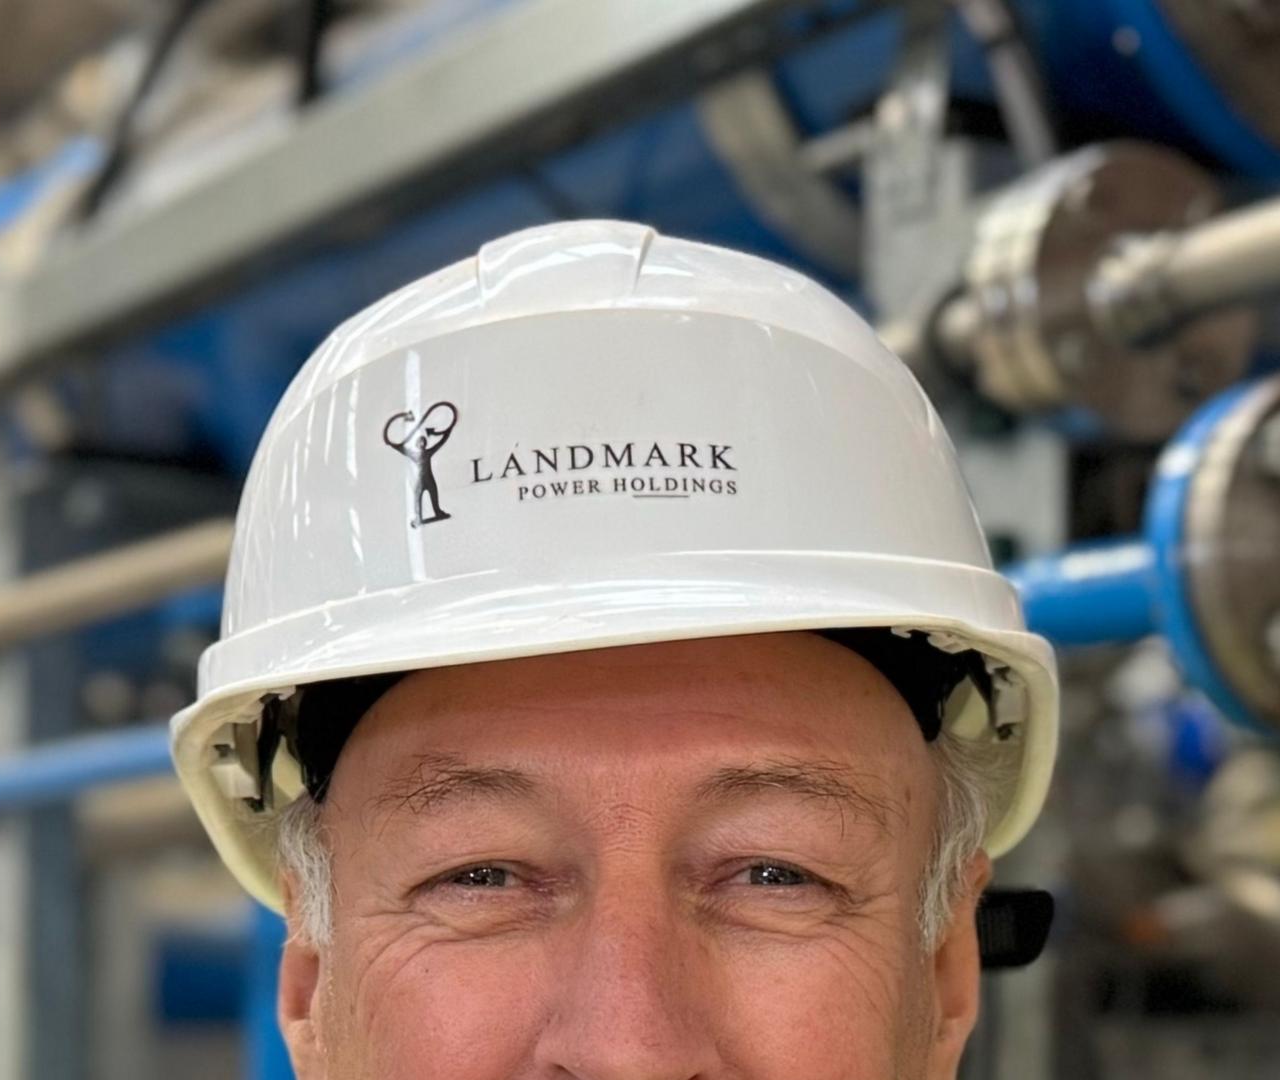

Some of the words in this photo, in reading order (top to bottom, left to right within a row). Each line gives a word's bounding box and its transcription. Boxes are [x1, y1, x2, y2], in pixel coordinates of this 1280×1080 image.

[471, 442, 737, 483] LANDMARK
[519, 479, 601, 501] POWER
[614, 478, 738, 496] HOLDINGS
